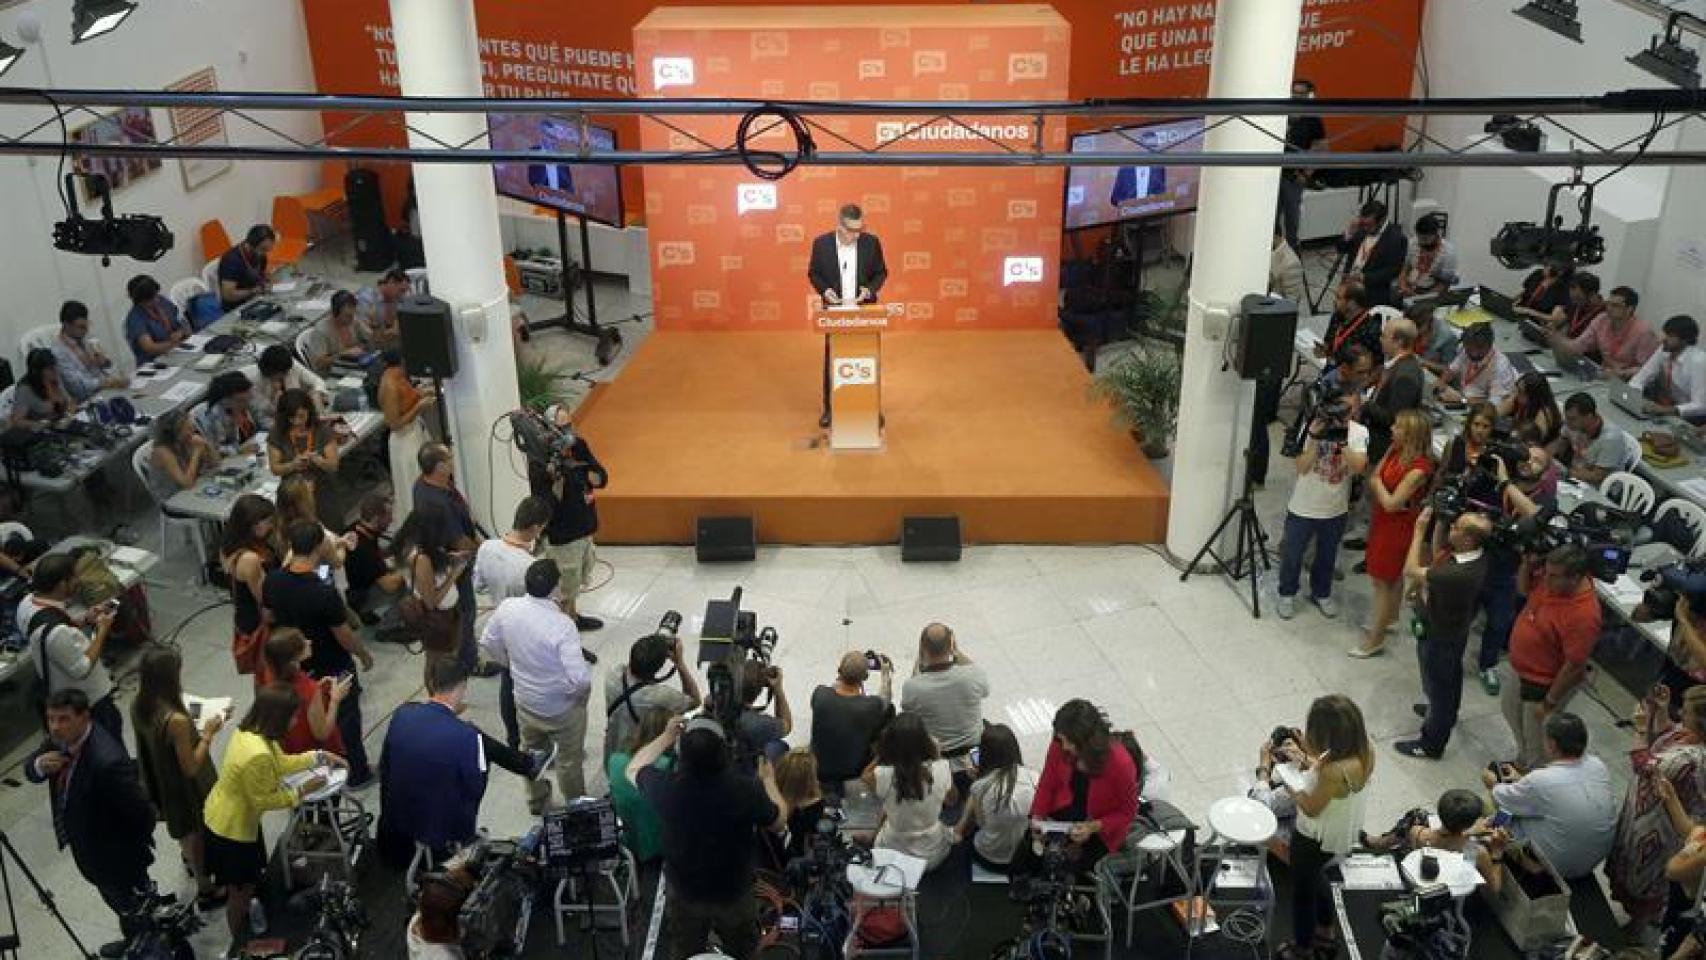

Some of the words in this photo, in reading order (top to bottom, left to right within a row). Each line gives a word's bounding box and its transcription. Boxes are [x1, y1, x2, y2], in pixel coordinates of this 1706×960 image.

[1152, 5, 1188, 26] HAY
[1192, 2, 1214, 21] NA
[479, 37, 522, 58] NTES
[525, 41, 561, 62] QUÉ
[564, 46, 623, 69] PUEDE
[1120, 57, 1141, 76] LE
[1145, 53, 1170, 73] HA
[1299, 30, 1354, 52] EMPO"
[1121, 31, 1157, 54] QUE
[1161, 26, 1198, 48] UNA
[502, 62, 613, 91] PREGÚNTATE
[616, 76, 639, 95] QU
[905, 121, 1029, 140] Ciudadanos
[838, 362, 871, 379] C's
